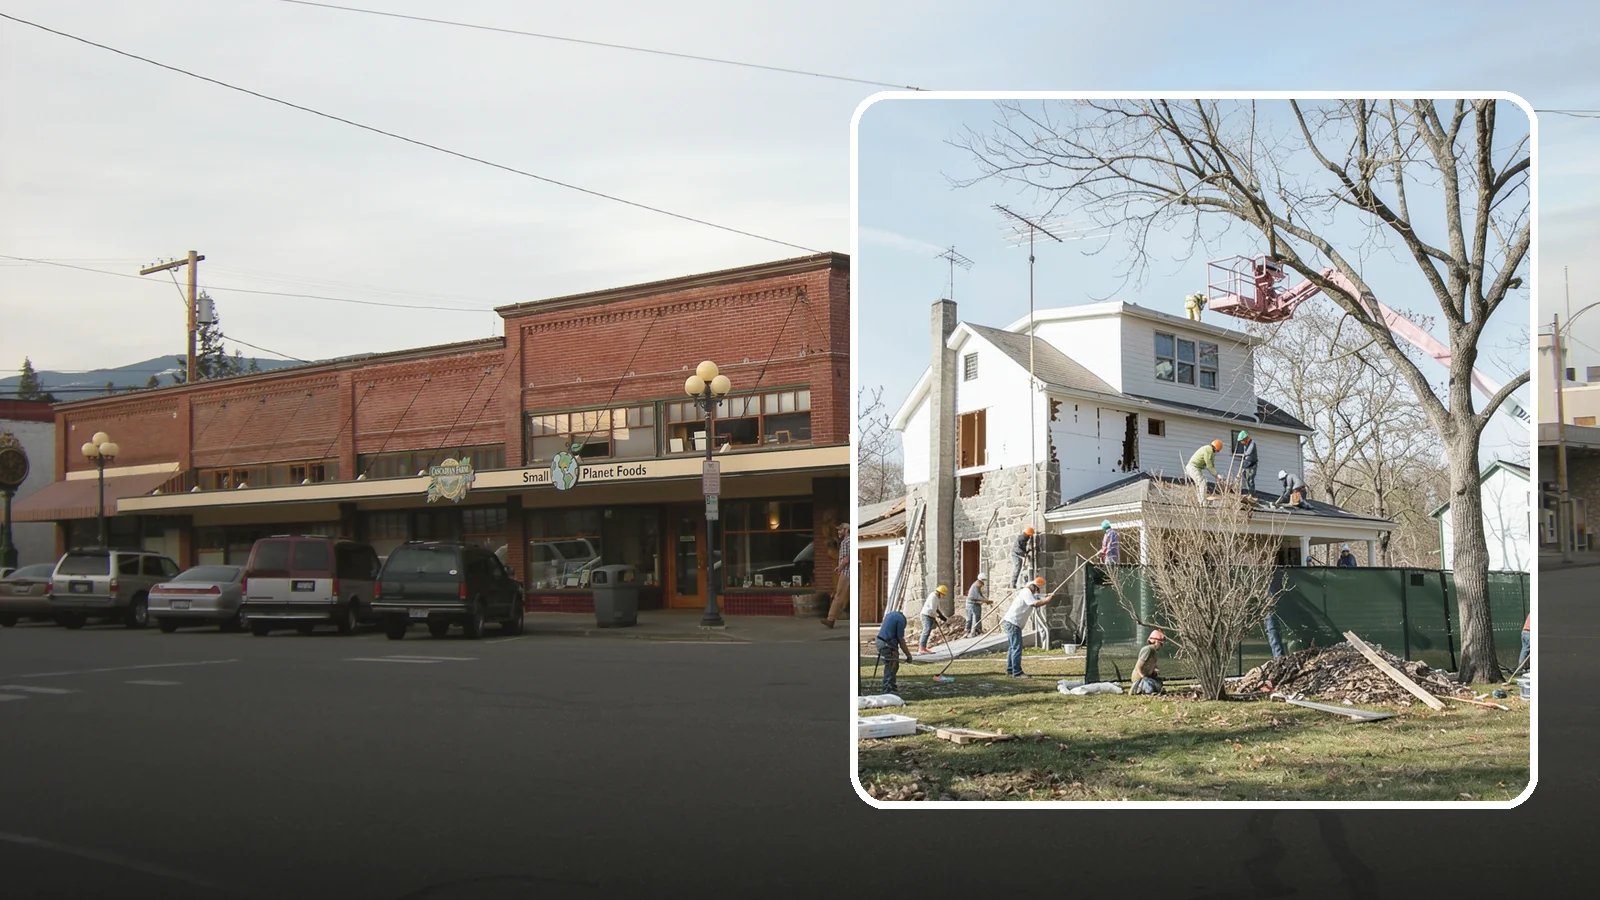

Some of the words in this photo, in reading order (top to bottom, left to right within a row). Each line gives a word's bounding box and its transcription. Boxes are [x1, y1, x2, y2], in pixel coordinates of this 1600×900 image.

[523, 471, 549, 483] Small
[583, 468, 614, 479] Planet
[617, 464, 647, 477] Foods
